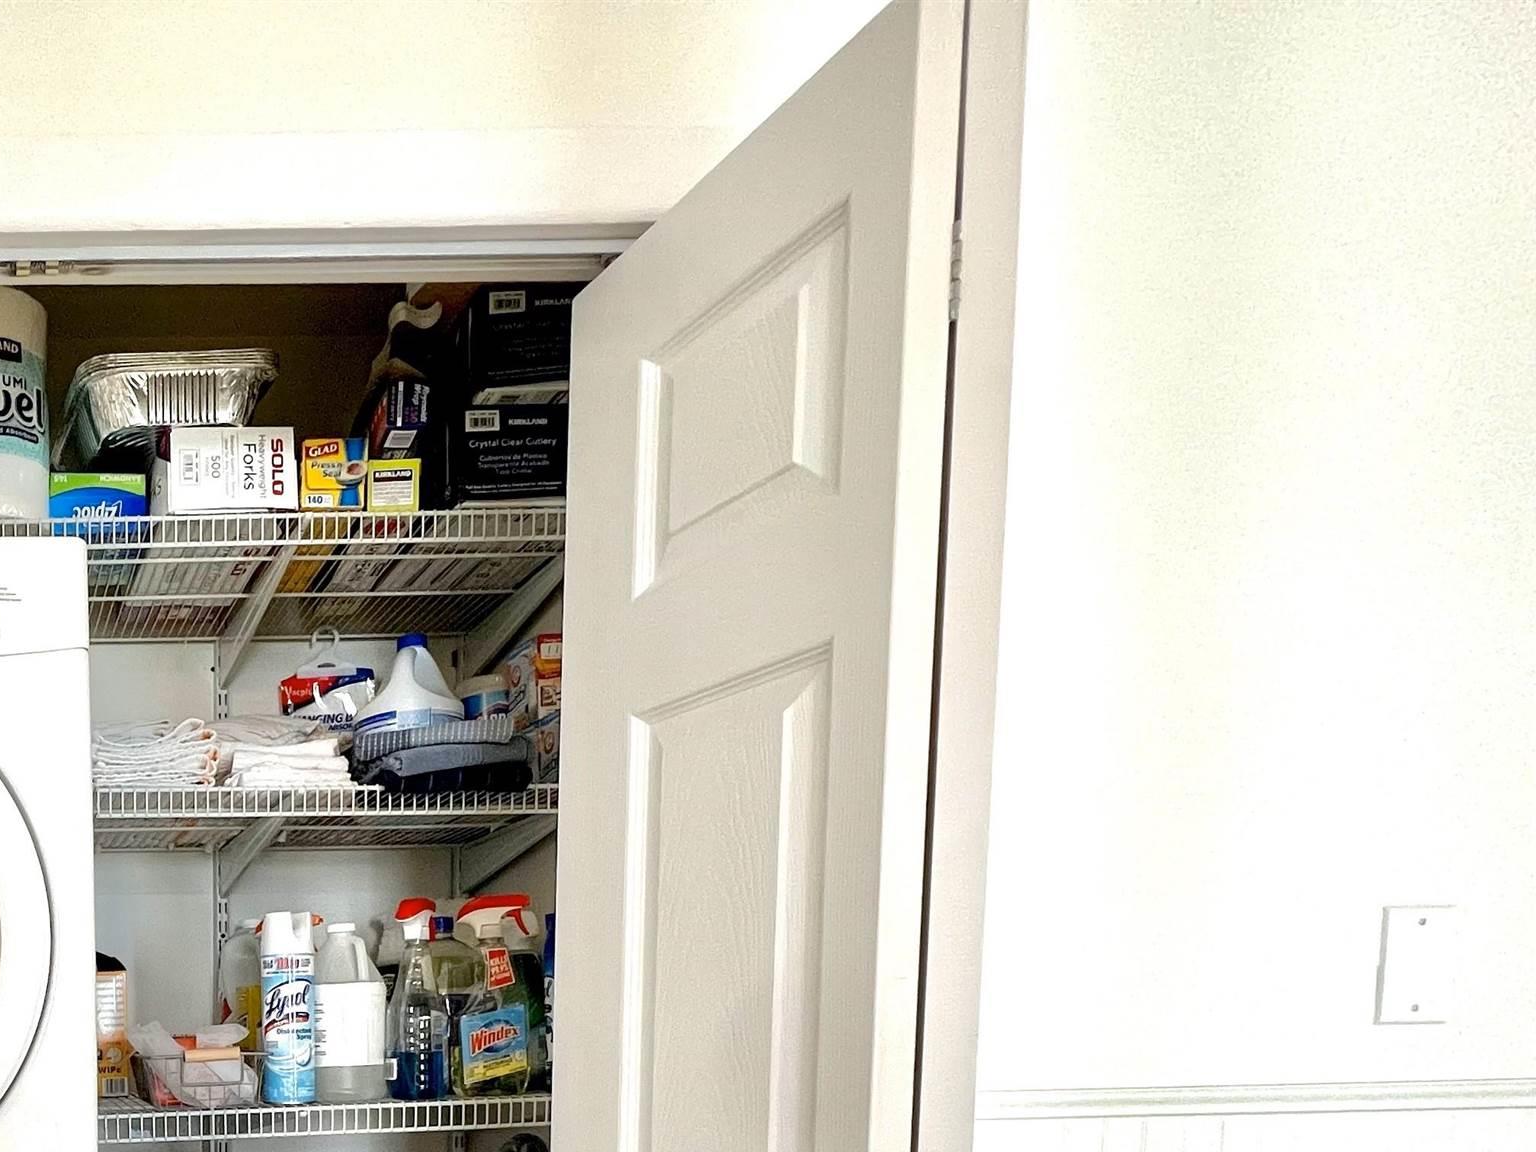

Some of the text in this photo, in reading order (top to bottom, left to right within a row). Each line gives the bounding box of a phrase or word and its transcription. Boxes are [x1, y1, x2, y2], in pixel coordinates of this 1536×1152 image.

[534, 298, 573, 306] KIRKLAN
[308, 443, 338, 457] GLAD
[468, 437, 558, 449] Crystal Clear Cutlery
[210, 455, 221, 479] 500
[242, 443, 257, 491] Forks
[258, 434, 267, 499] Heavyweight
[270, 438, 285, 496] SOLO
[307, 495, 323, 504] 140
[470, 1026, 520, 1056] Windex
